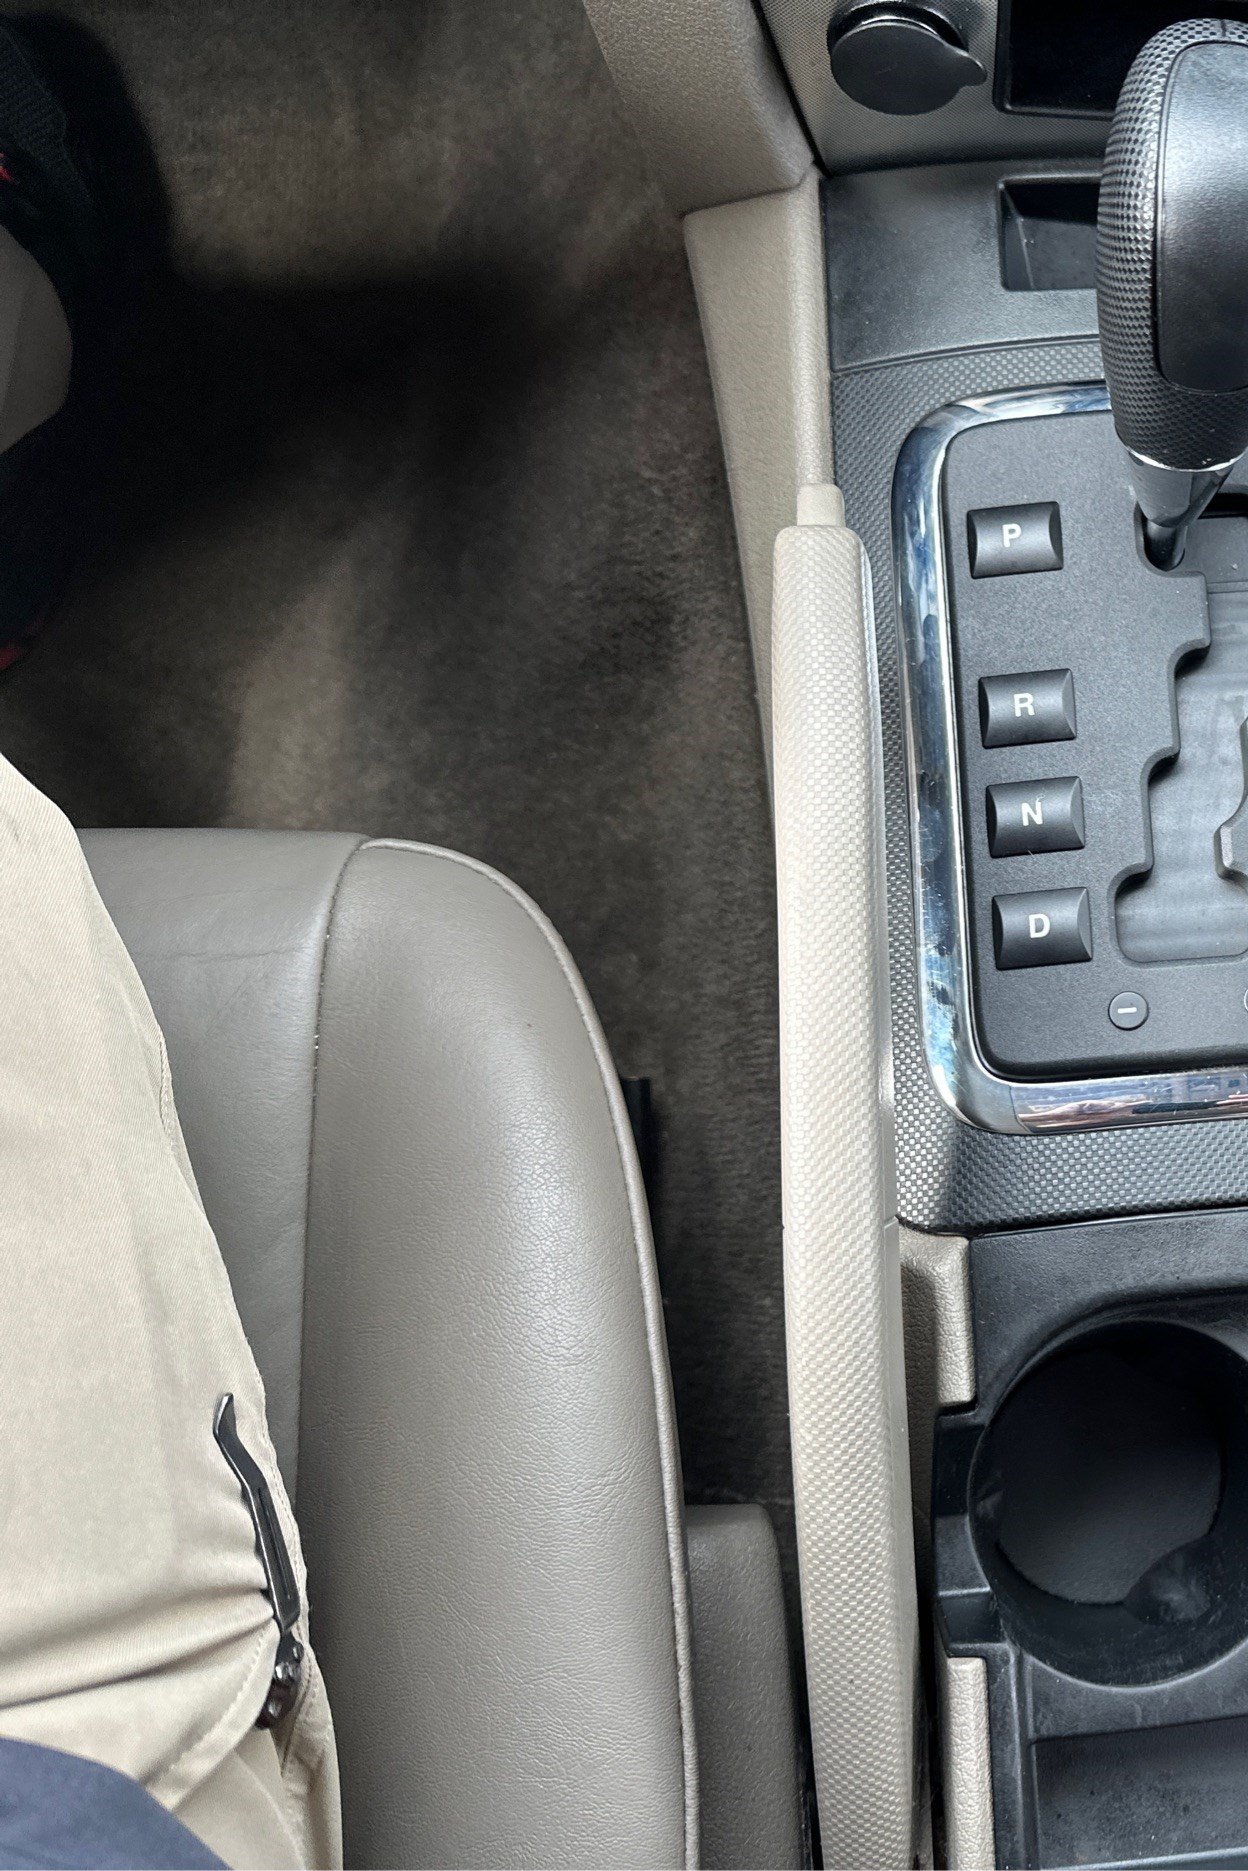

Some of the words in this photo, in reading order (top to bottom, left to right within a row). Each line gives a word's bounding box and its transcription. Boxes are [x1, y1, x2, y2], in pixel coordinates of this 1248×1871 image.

[1002, 523, 1022, 548] P
[1013, 692, 1036, 718] R
[1021, 801, 1043, 826] N
[1028, 913, 1051, 940] D
